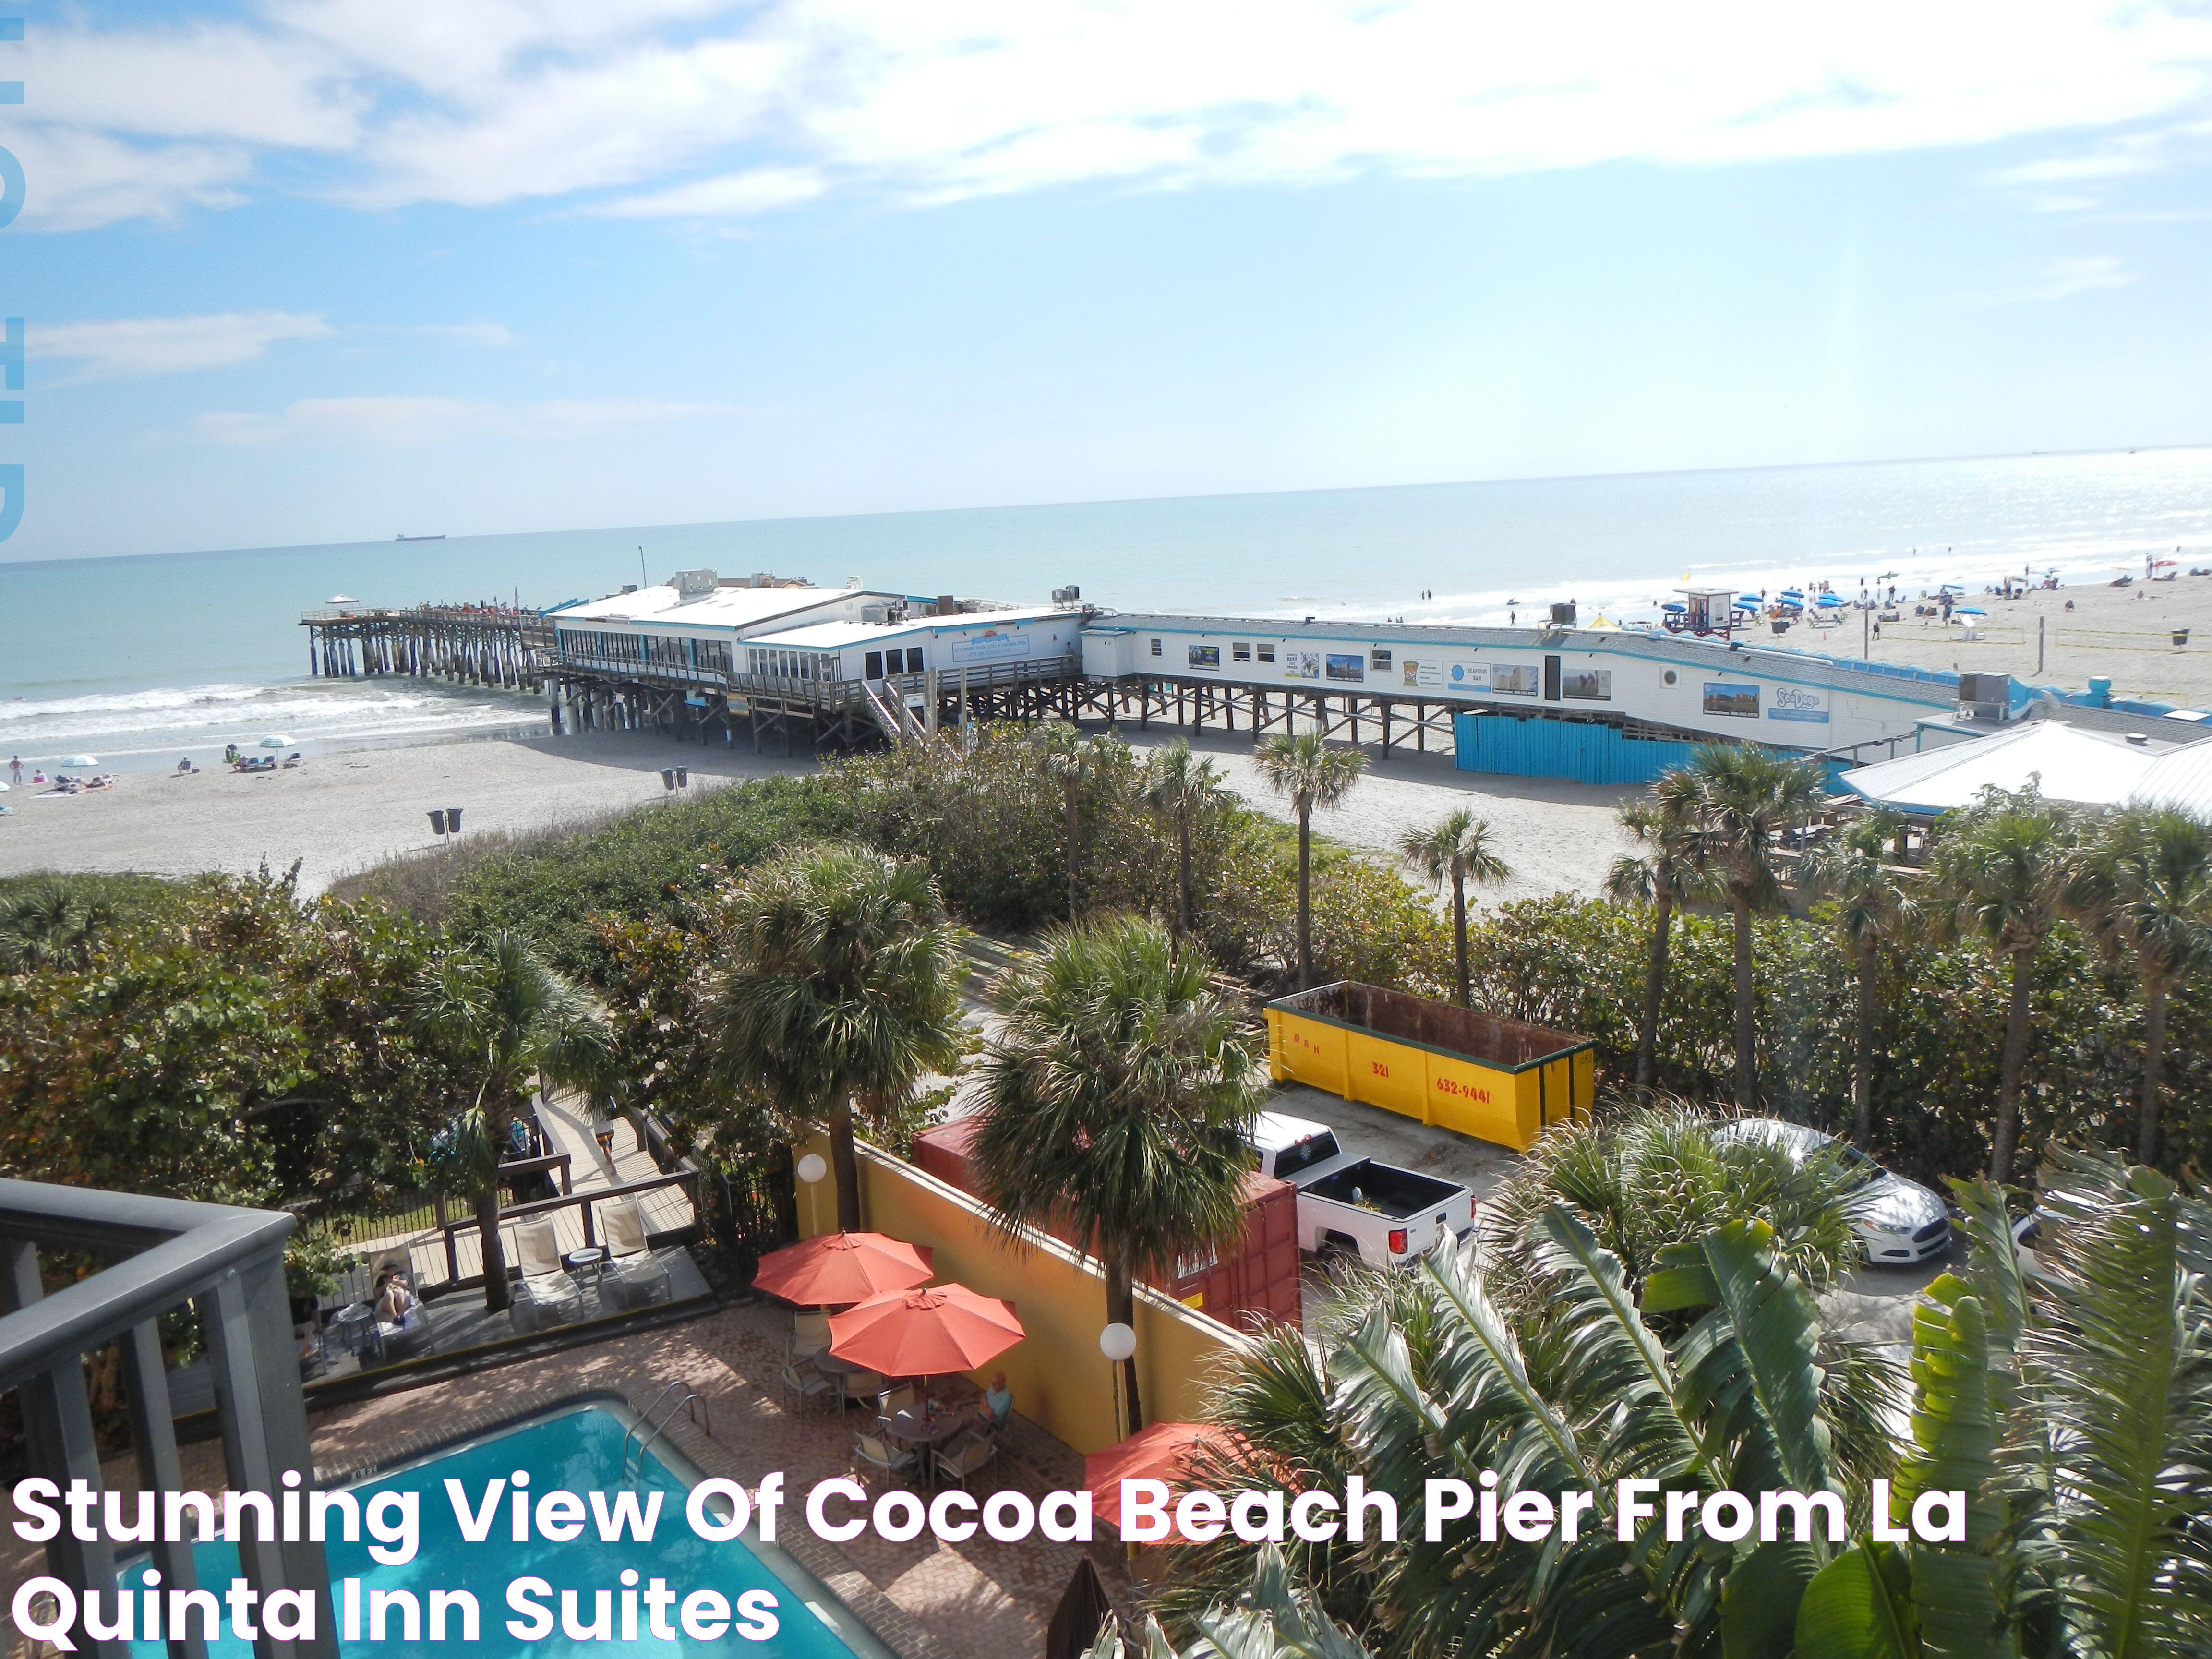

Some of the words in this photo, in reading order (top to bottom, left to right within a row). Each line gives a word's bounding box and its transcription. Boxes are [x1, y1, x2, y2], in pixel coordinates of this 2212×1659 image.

[1777, 687, 1820, 709] SeaDogs
[1372, 1062, 1389, 1078] 321
[1437, 1078, 1490, 1104] 632-9441
[365, 1466, 374, 1476] FT
